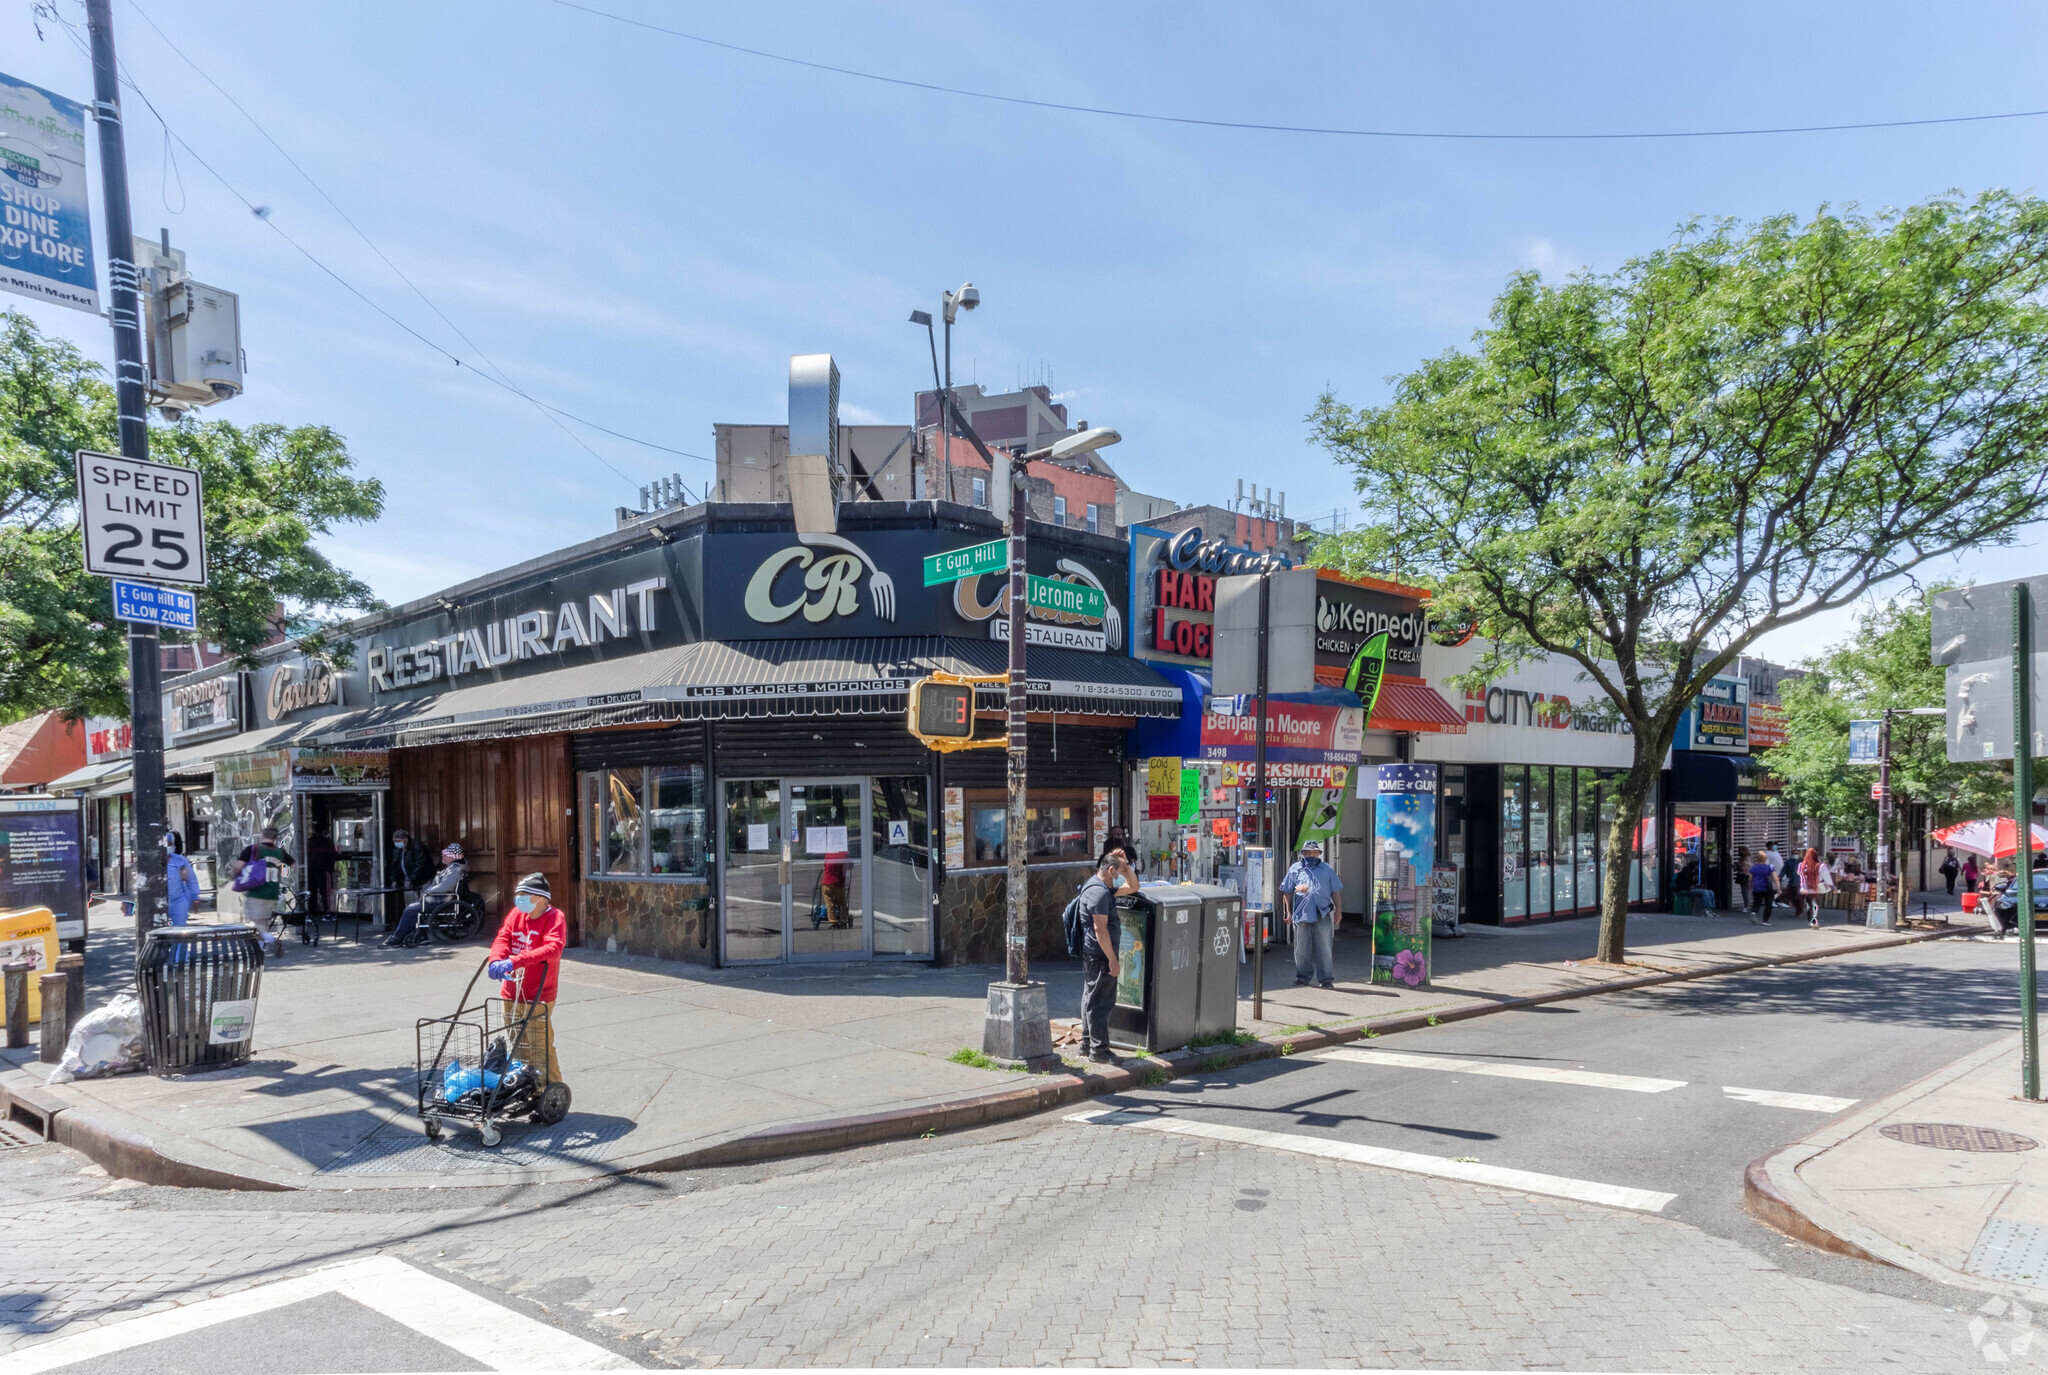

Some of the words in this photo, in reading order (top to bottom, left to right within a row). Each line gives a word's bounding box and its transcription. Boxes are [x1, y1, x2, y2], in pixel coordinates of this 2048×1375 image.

[8, 162, 32, 177] GUN
[34, 169, 57, 184] HILL
[18, 174, 36, 187] BID
[0, 184, 61, 217] SHOP
[6, 204, 60, 239] DINE
[11, 277, 42, 293] Mini
[45, 287, 92, 306] Market
[92, 465, 190, 497] SPEED
[105, 493, 182, 520] LIMIT
[102, 522, 190, 571] 25
[936, 557, 943, 573] E
[946, 553, 970, 570] Gun
[975, 544, 996, 562] Hill
[957, 565, 974, 577] Road
[120, 586, 127, 599] E
[132, 587, 154, 602] Gun
[157, 592, 174, 607] Hill
[178, 597, 190, 610] Rd
[1031, 580, 1084, 611] Jerome
[1088, 591, 1099, 606] Av
[1157, 569, 1218, 613] HAR
[121, 602, 158, 619] SLOW
[161, 609, 192, 625] ZONE
[367, 576, 667, 694] RESTAURANT
[999, 622, 1104, 649] RSTAURANT
[1340, 602, 1424, 648] Kennedy
[1317, 637, 1350, 654] CHICKEN
[1386, 647, 1397, 660] ICE
[1398, 648, 1422, 663] CREAM
[268, 663, 331, 721] Caribe
[693, 686, 725, 697] LOS
[732, 684, 808, 695] MEJORES
[814, 679, 906, 692] MOFONGOS
[1074, 684, 1142, 697] 718-324-5300
[1149, 688, 1174, 699] 6700
[1358, 662, 1380, 711] obile
[1701, 683, 1731, 699] National
[504, 703, 552, 717] 718-324-5300
[557, 700, 577, 710] 6700
[588, 697, 604, 706] FREE
[606, 692, 640, 703] DELIVERY
[1573, 711, 1618, 734] URGENT
[1703, 701, 1743, 725] BAKERY
[1207, 714, 1275, 736] Benjamn
[1277, 713, 1321, 735] Moore
[1243, 732, 1281, 743] Autrize
[1283, 734, 1307, 745] Dealer
[1207, 747, 1227, 758] 3498
[1237, 762, 1331, 778] LOCKSMITH
[1149, 780, 1174, 795] SALE
[1245, 777, 1325, 787] 7-654-4350
[15, 801, 57, 811] TITAN
[892, 823, 905, 838] A
[16, 926, 51, 937] GRATIS
[227, 1031, 239, 1039] BID
